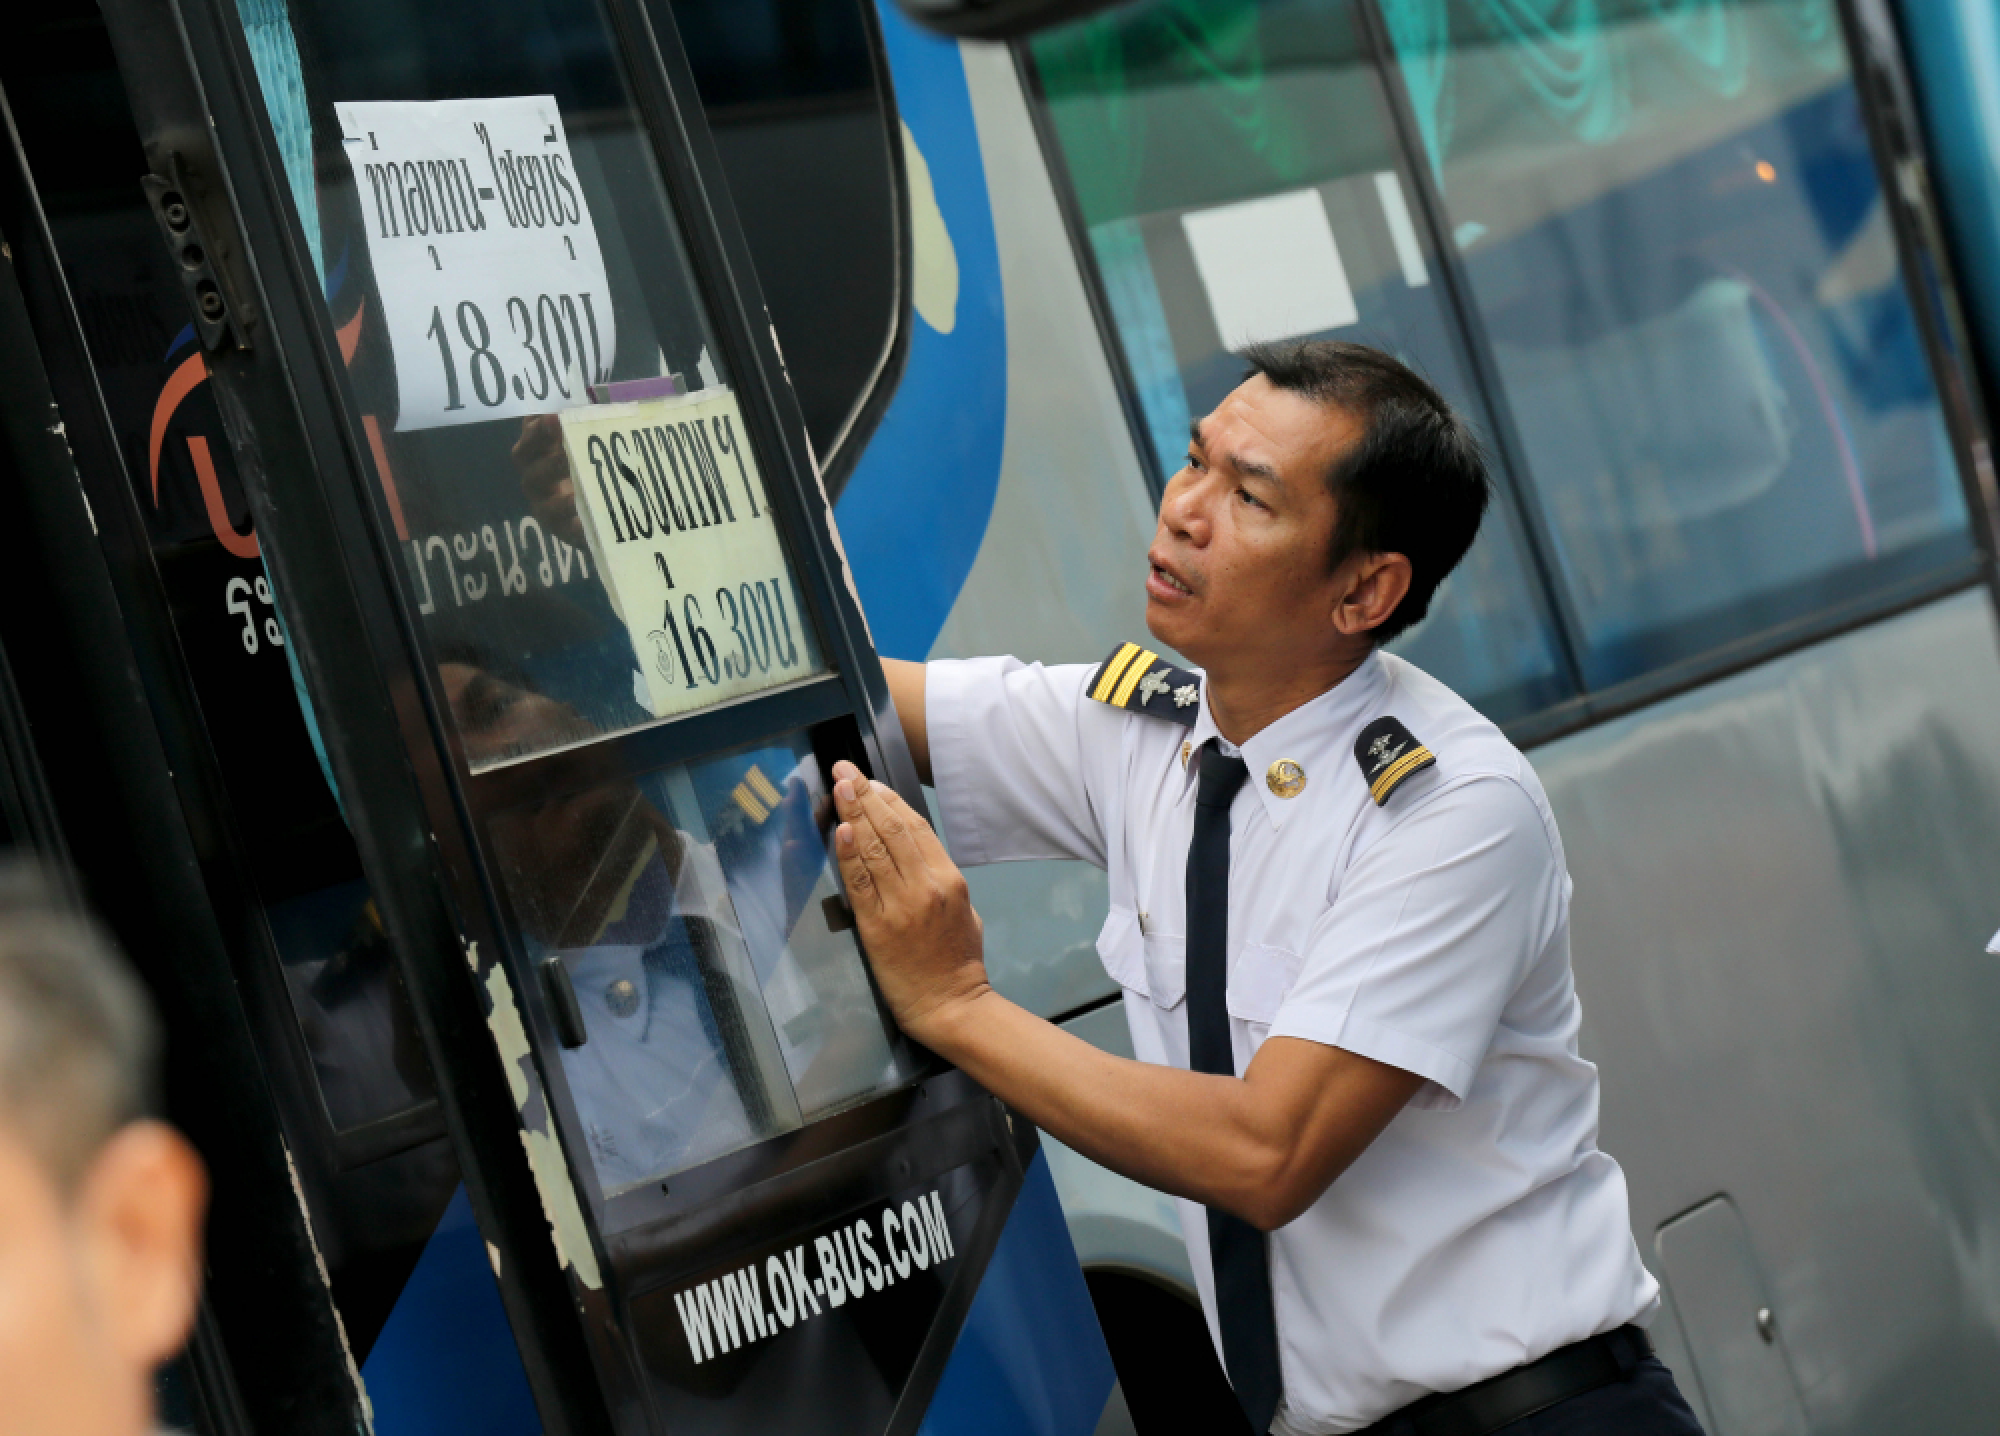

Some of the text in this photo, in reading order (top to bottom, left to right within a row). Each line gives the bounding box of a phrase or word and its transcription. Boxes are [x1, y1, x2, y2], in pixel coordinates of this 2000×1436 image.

[587, 413, 761, 589] กรุงเทพฯ
[673, 1189, 955, 1365] WWW.OK-BUS.COM
